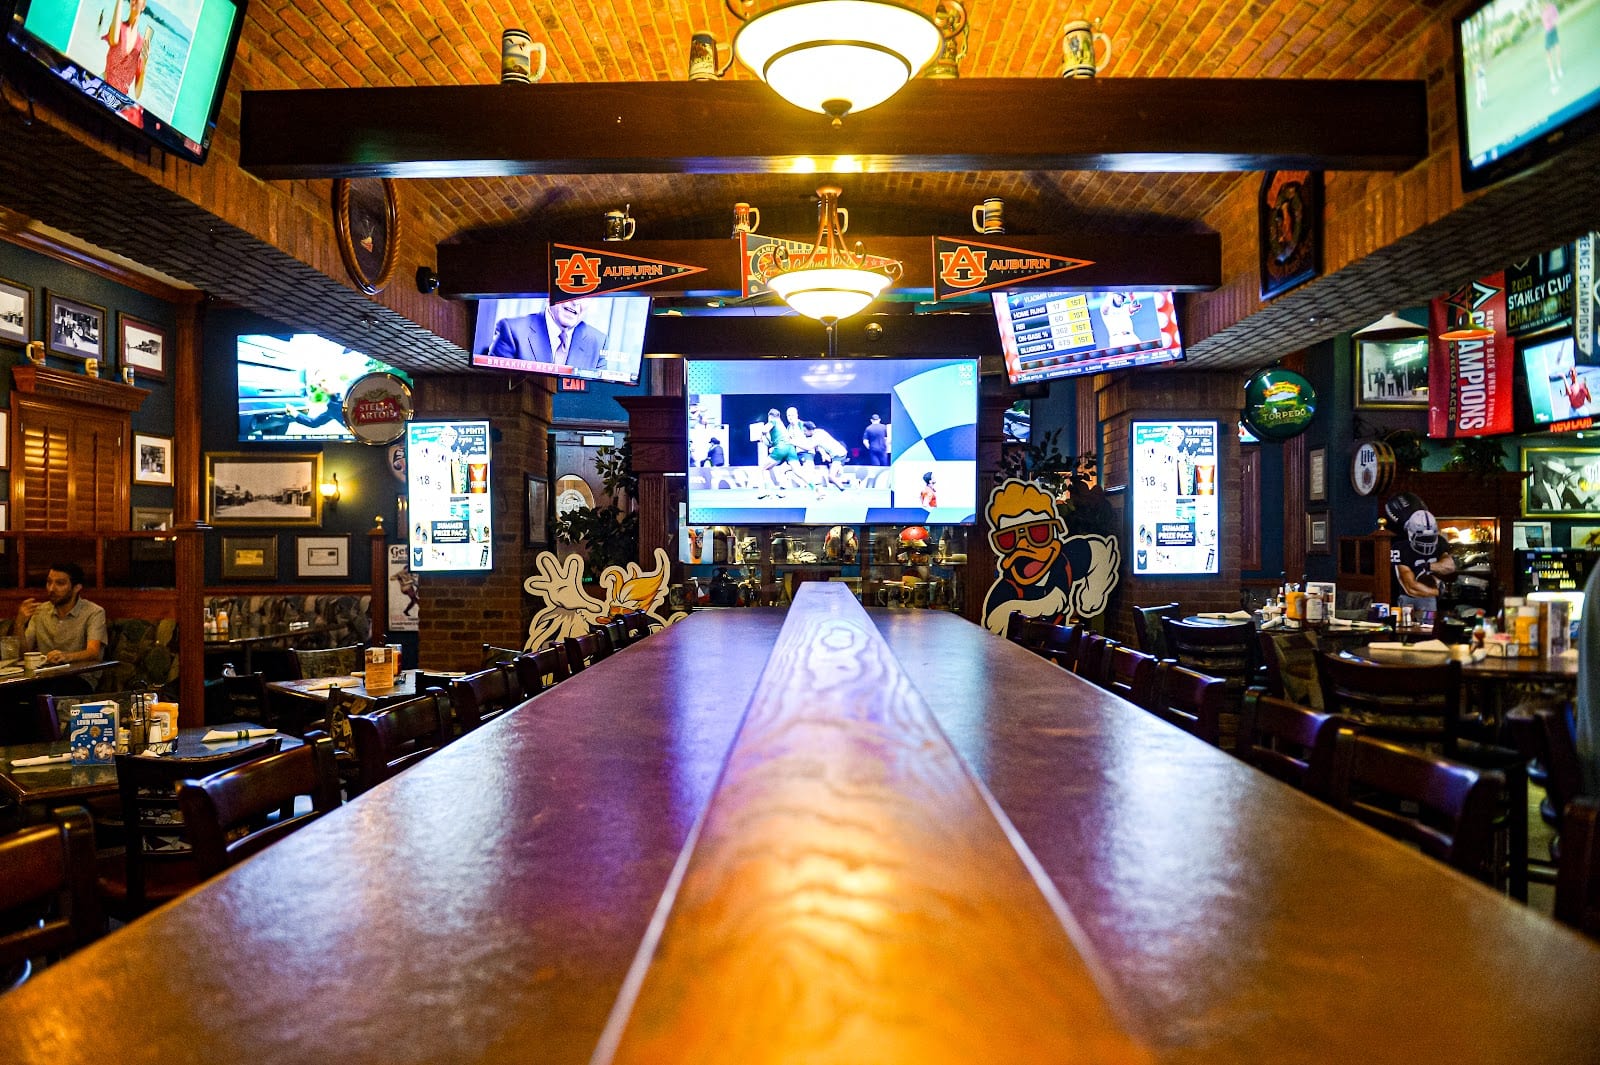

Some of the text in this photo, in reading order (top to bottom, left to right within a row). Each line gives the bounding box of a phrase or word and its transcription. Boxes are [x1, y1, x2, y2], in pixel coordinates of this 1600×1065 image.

[603, 265, 663, 277] AUBURN
[989, 259, 1050, 271] AUBURN
[1508, 274, 1572, 310] STANLEY CUP
[1013, 310, 1028, 318] HOME
[1030, 308, 1046, 316] RUNS
[1508, 290, 1572, 328] CHAMPIONS
[1580, 274, 1591, 340] CHAMPIONS
[1018, 333, 1042, 342] ON-BASE
[1020, 345, 1046, 354] SLUGGING
[1487, 348, 1495, 369] BACK
[487, 358, 560, 373] BREAKING NEWS
[1458, 310, 1486, 430] CAMPIONS
[562, 379, 585, 390] EXIT
[360, 402, 394, 412] STELLA
[1487, 398, 1495, 427] FINALS
[360, 410, 398, 420] ARTOIS
[1263, 408, 1306, 420] TORPEDO
[1360, 450, 1375, 466] Lite
